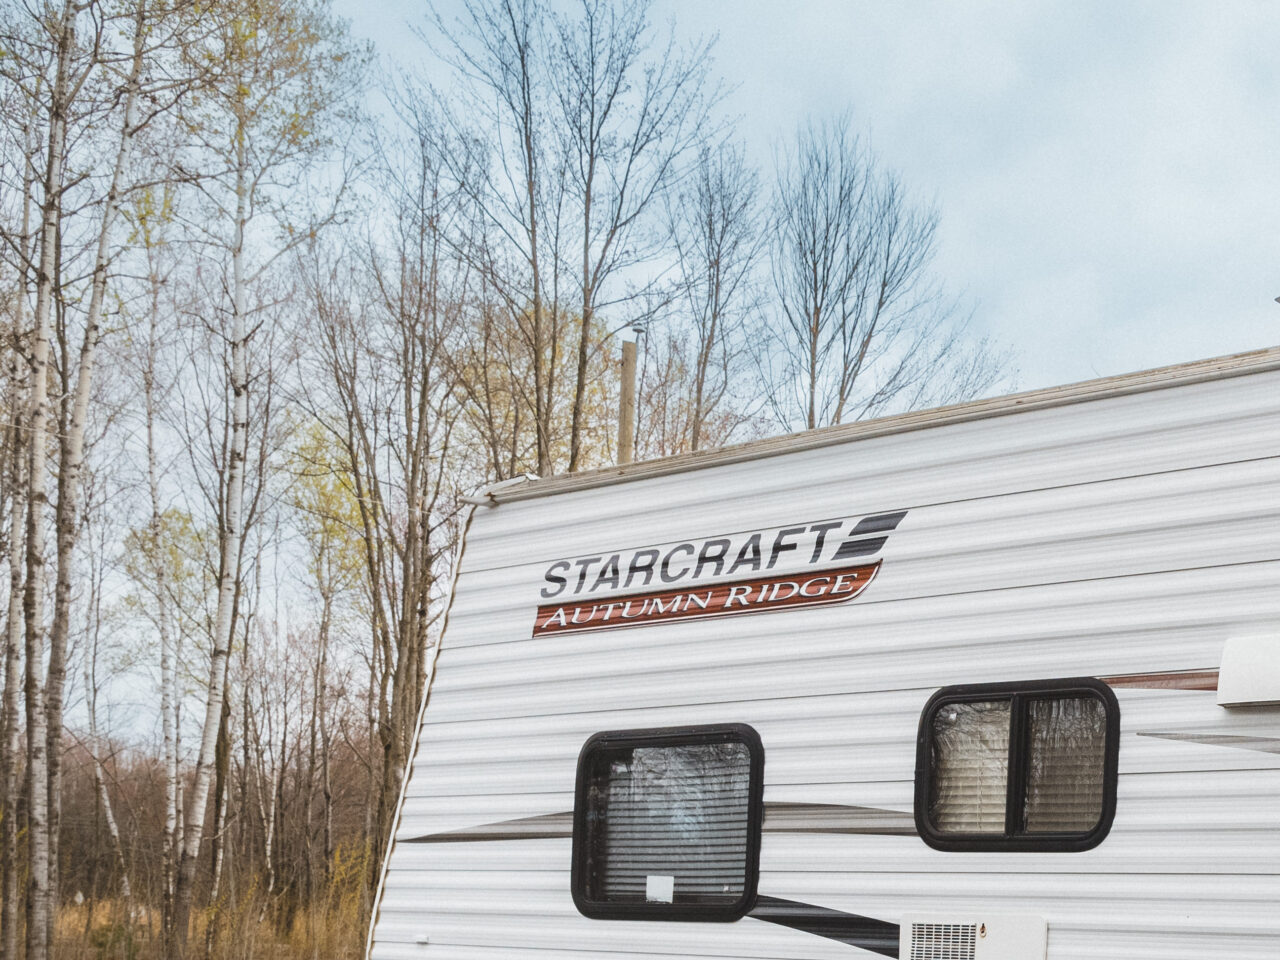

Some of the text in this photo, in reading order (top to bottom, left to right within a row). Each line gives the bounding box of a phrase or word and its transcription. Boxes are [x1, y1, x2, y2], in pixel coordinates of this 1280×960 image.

[540, 521, 843, 598] STARCRAFT
[541, 573, 859, 628] AUTUMN RIDGE
